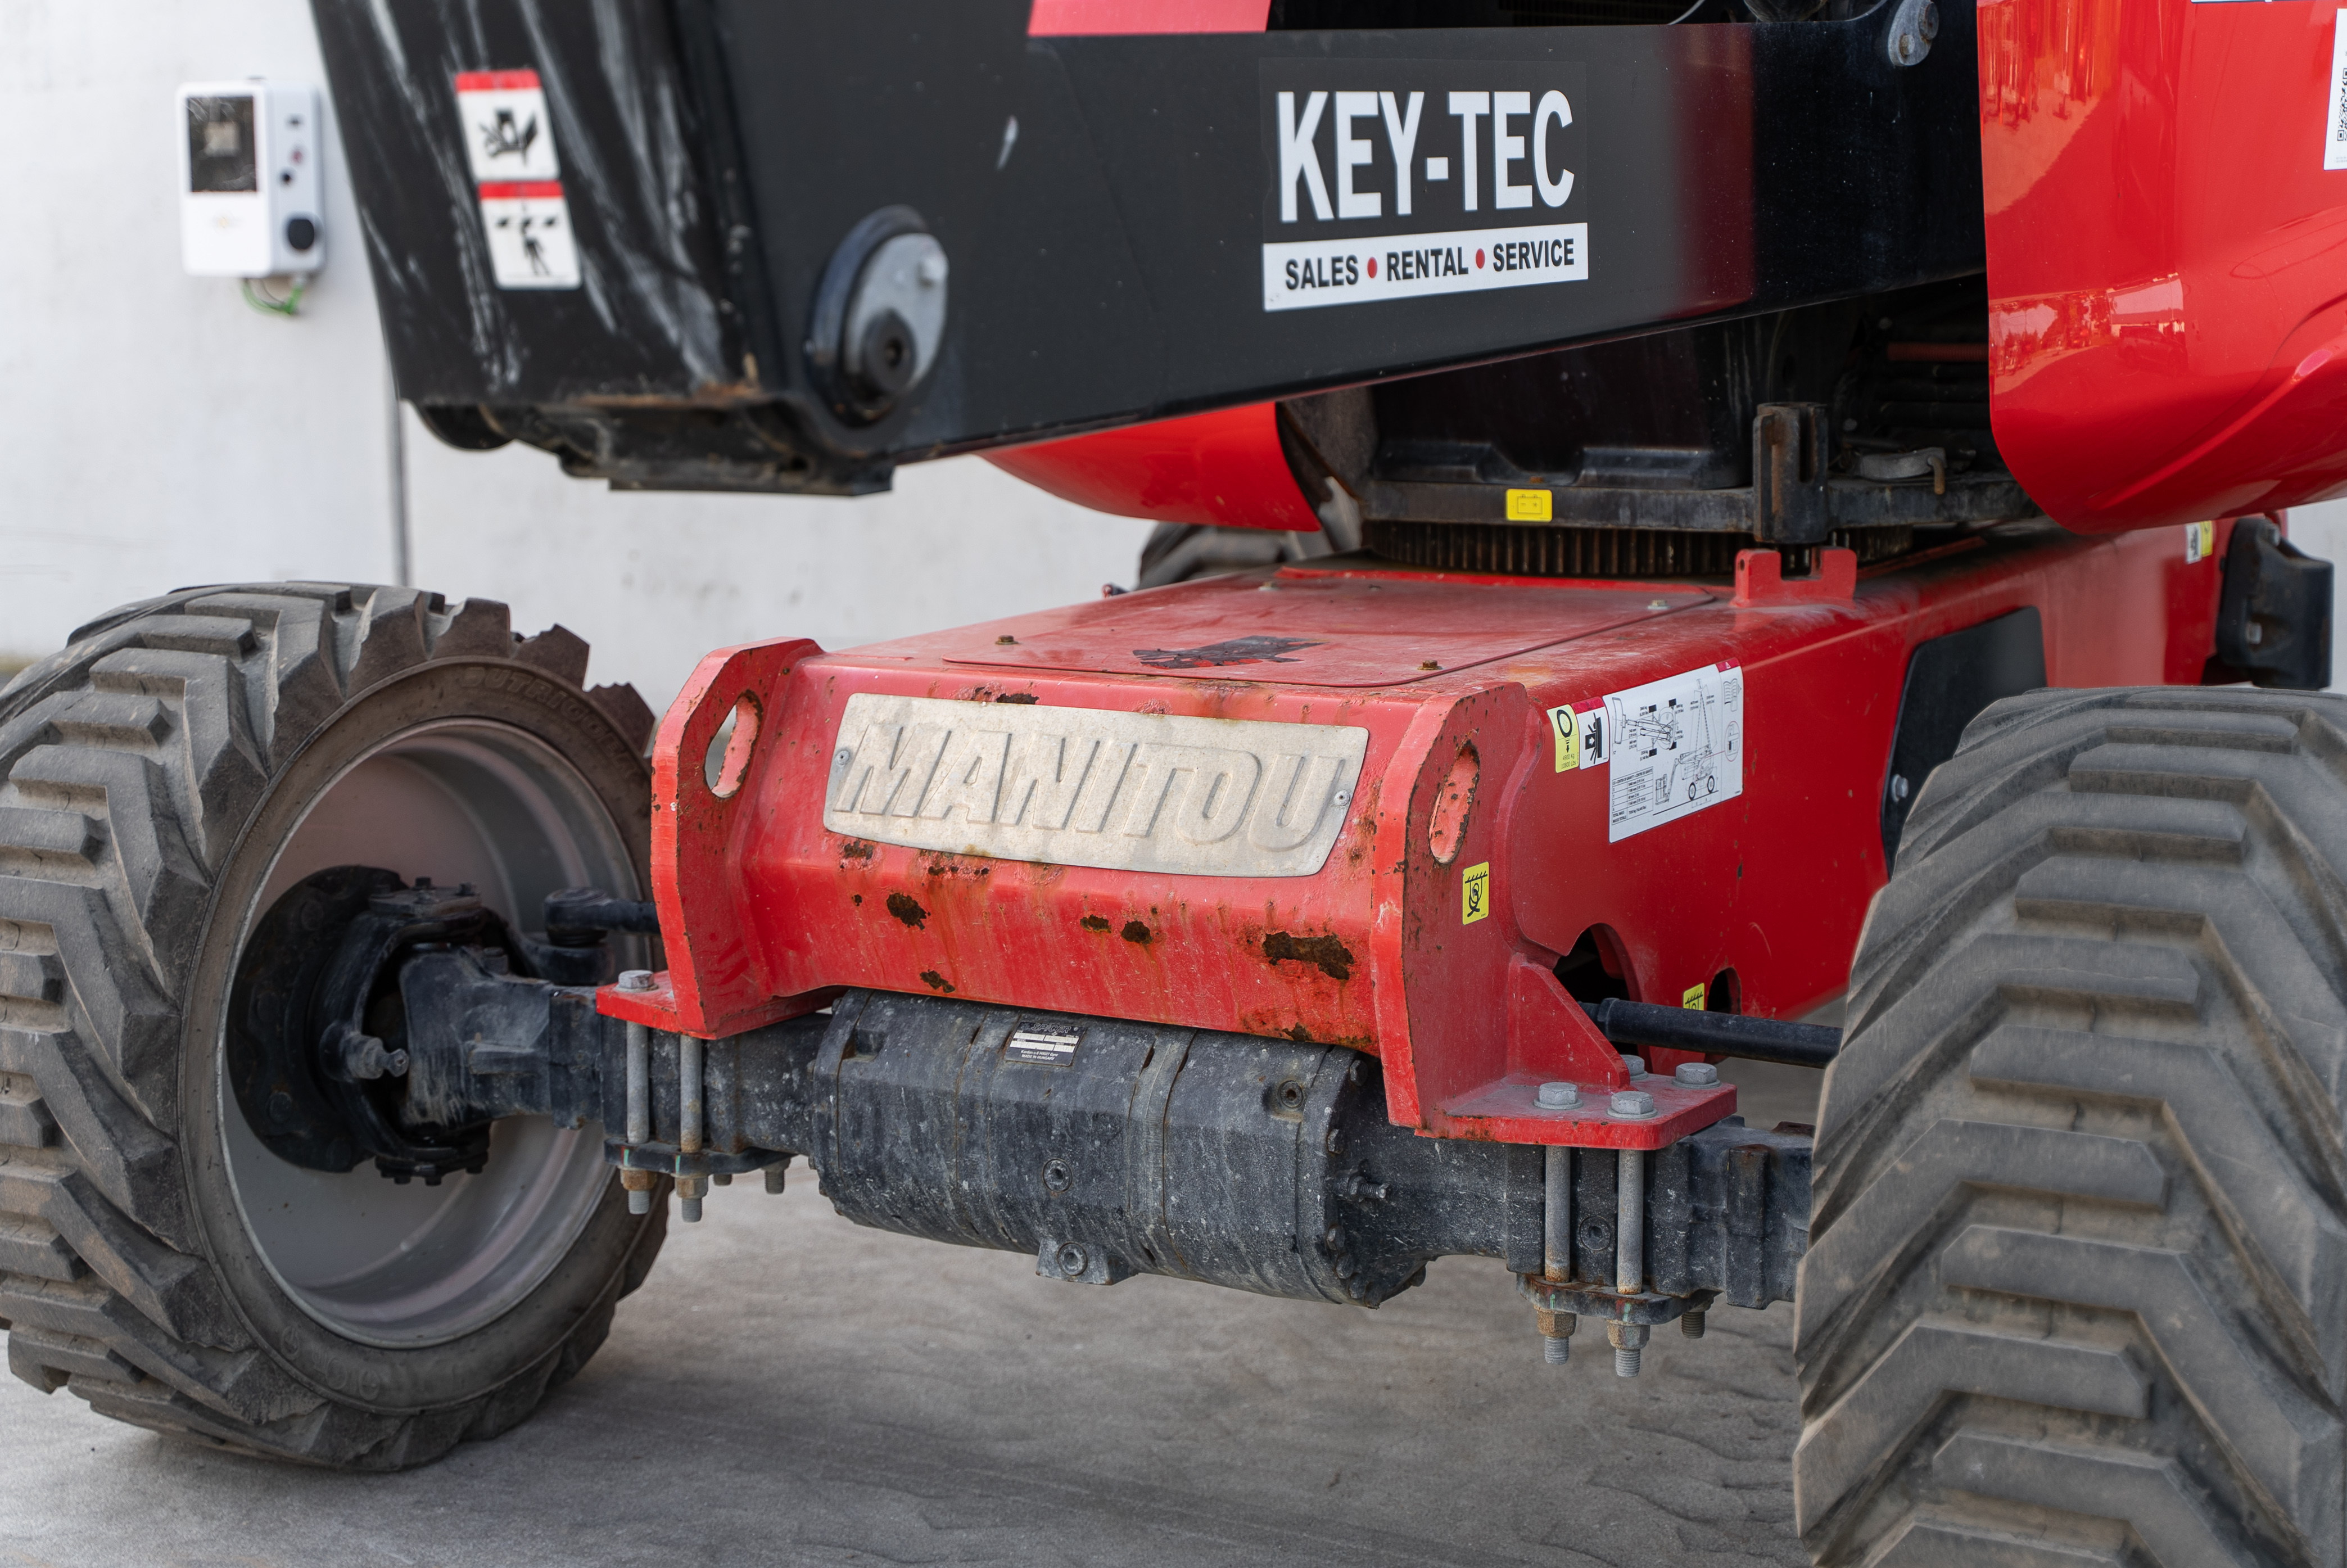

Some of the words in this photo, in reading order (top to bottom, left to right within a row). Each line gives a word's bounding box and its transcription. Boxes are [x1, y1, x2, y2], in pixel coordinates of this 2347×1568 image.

[1277, 89, 1575, 223] KEY-TEC
[1285, 254, 1359, 291] SALES
[1386, 246, 1469, 282] RENTAL
[1492, 238, 1575, 272] SERVICE
[459, 666, 640, 780] OUTRIGGER
[833, 723, 1347, 852] MANITOU
[1030, 1023, 1071, 1033] SPICER
